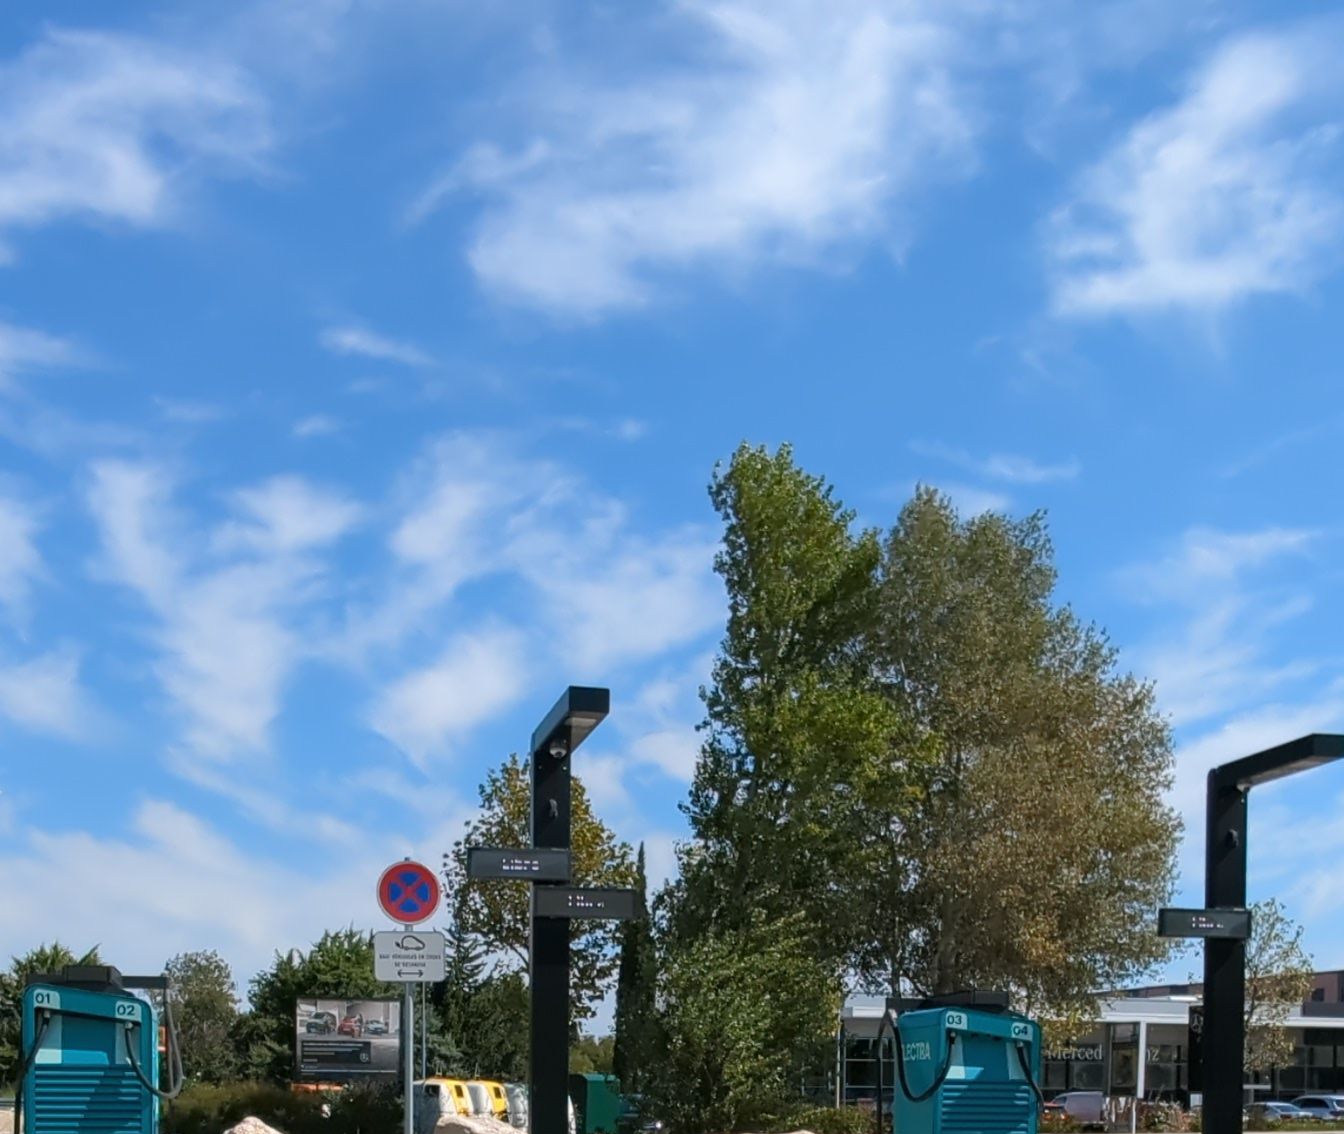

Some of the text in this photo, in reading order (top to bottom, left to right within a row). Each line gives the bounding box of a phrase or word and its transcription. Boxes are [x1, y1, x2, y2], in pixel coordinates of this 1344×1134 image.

[35, 992, 51, 1004] 01
[117, 1004, 135, 1016] 02
[946, 1015, 962, 1025] 03
[1013, 1026, 1028, 1036] 04
[901, 1041, 931, 1062] LECTRA
